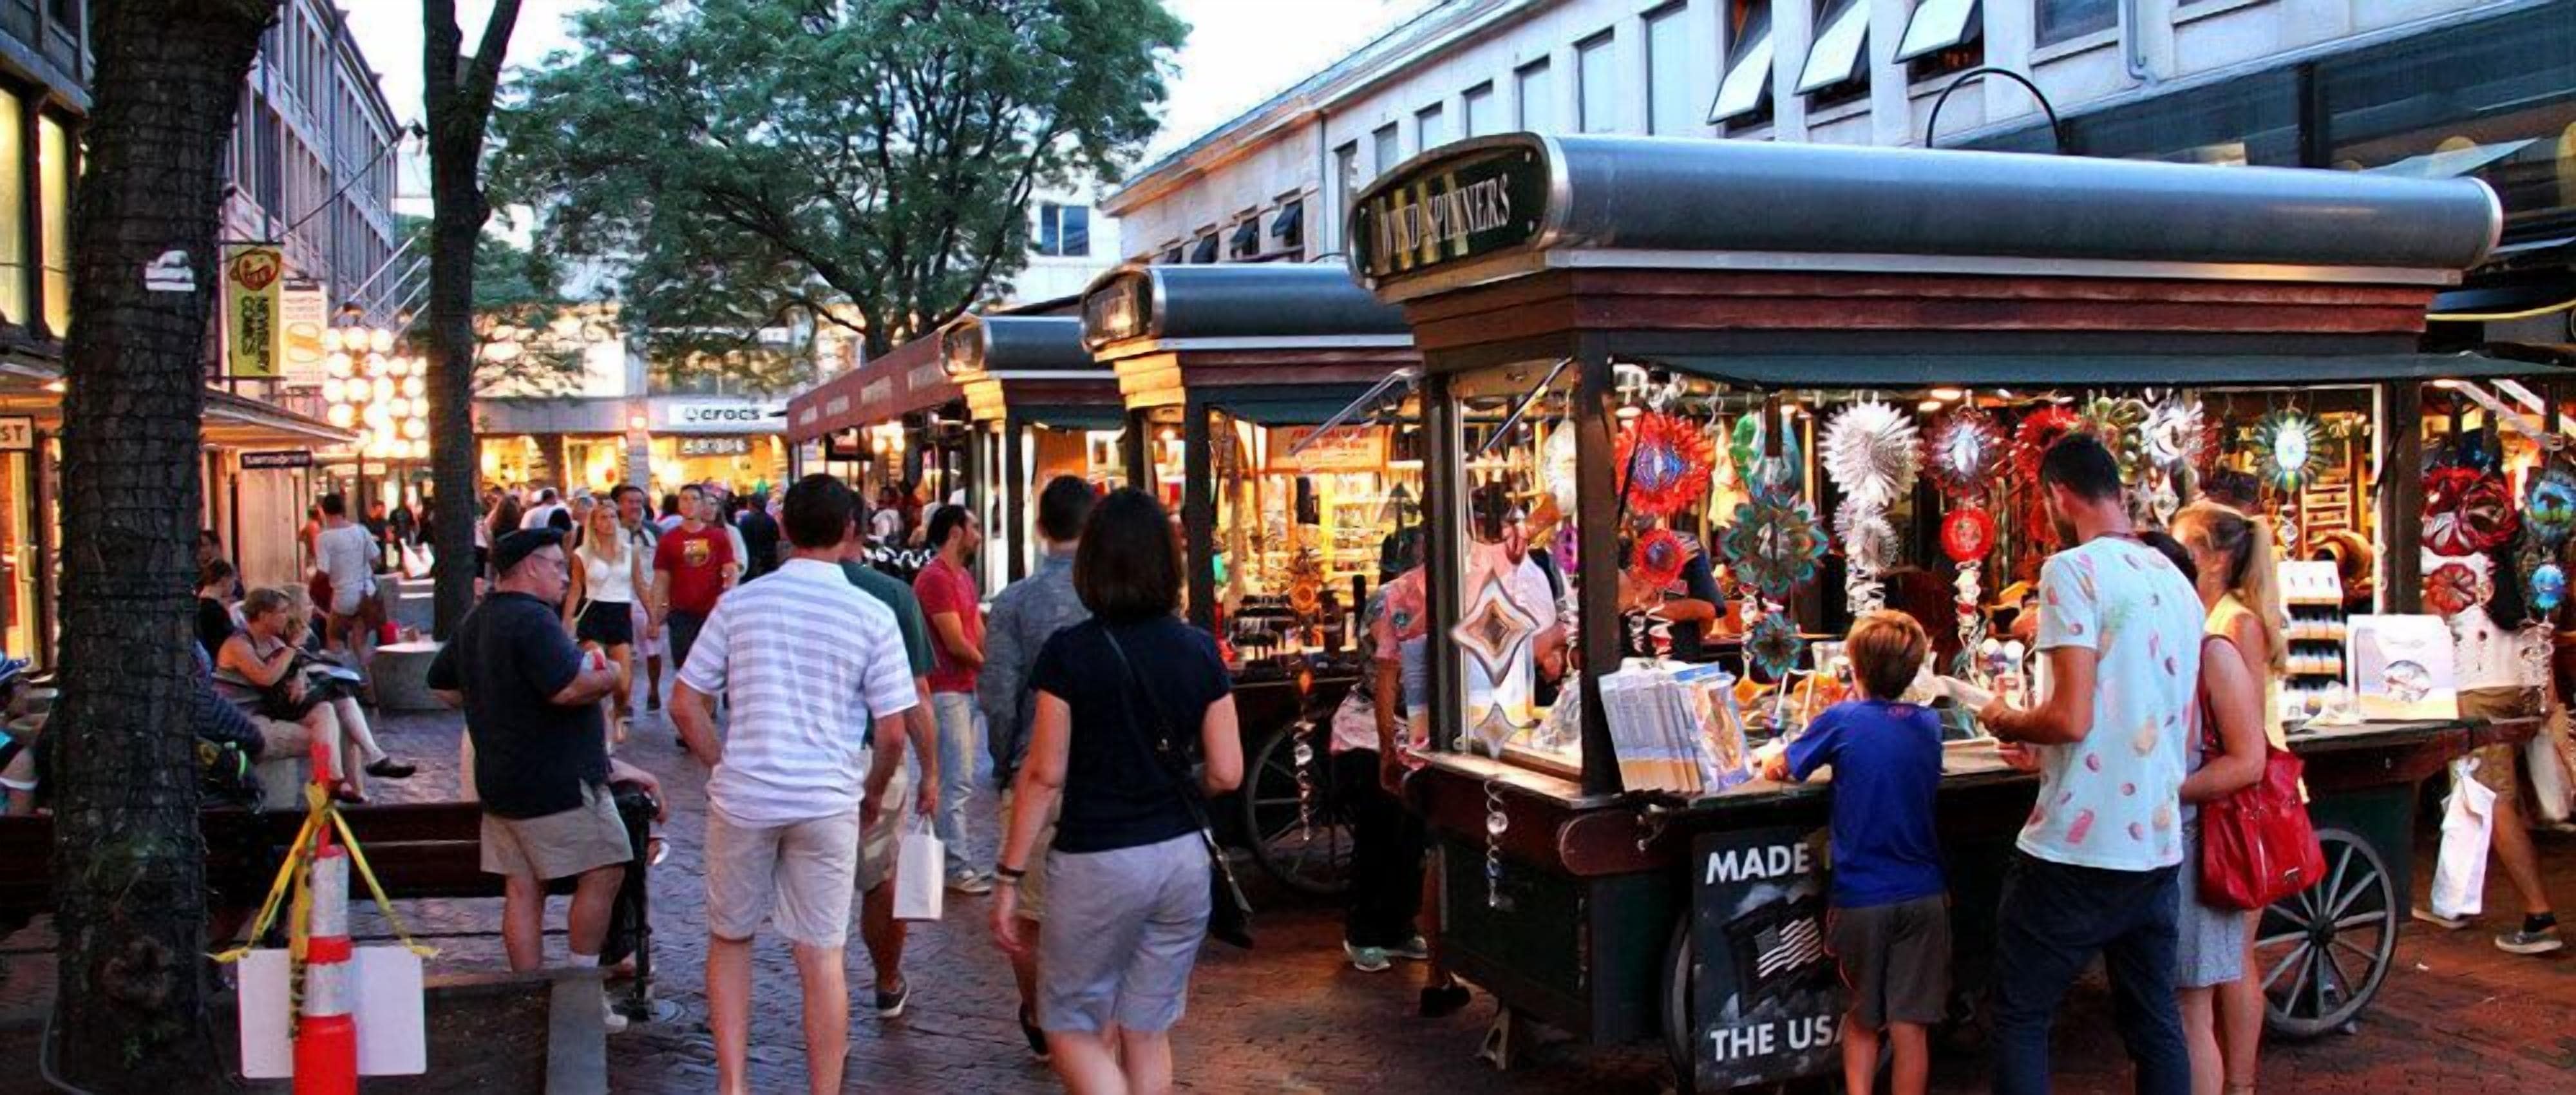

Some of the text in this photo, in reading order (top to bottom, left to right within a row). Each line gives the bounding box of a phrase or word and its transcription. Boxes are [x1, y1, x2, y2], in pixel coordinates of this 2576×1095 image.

[1372, 173, 1510, 258] WIND SPINNERS
[701, 410, 760, 420] crocs
[1706, 843, 1810, 884] MADE
[1710, 1023, 1775, 1062] THE
